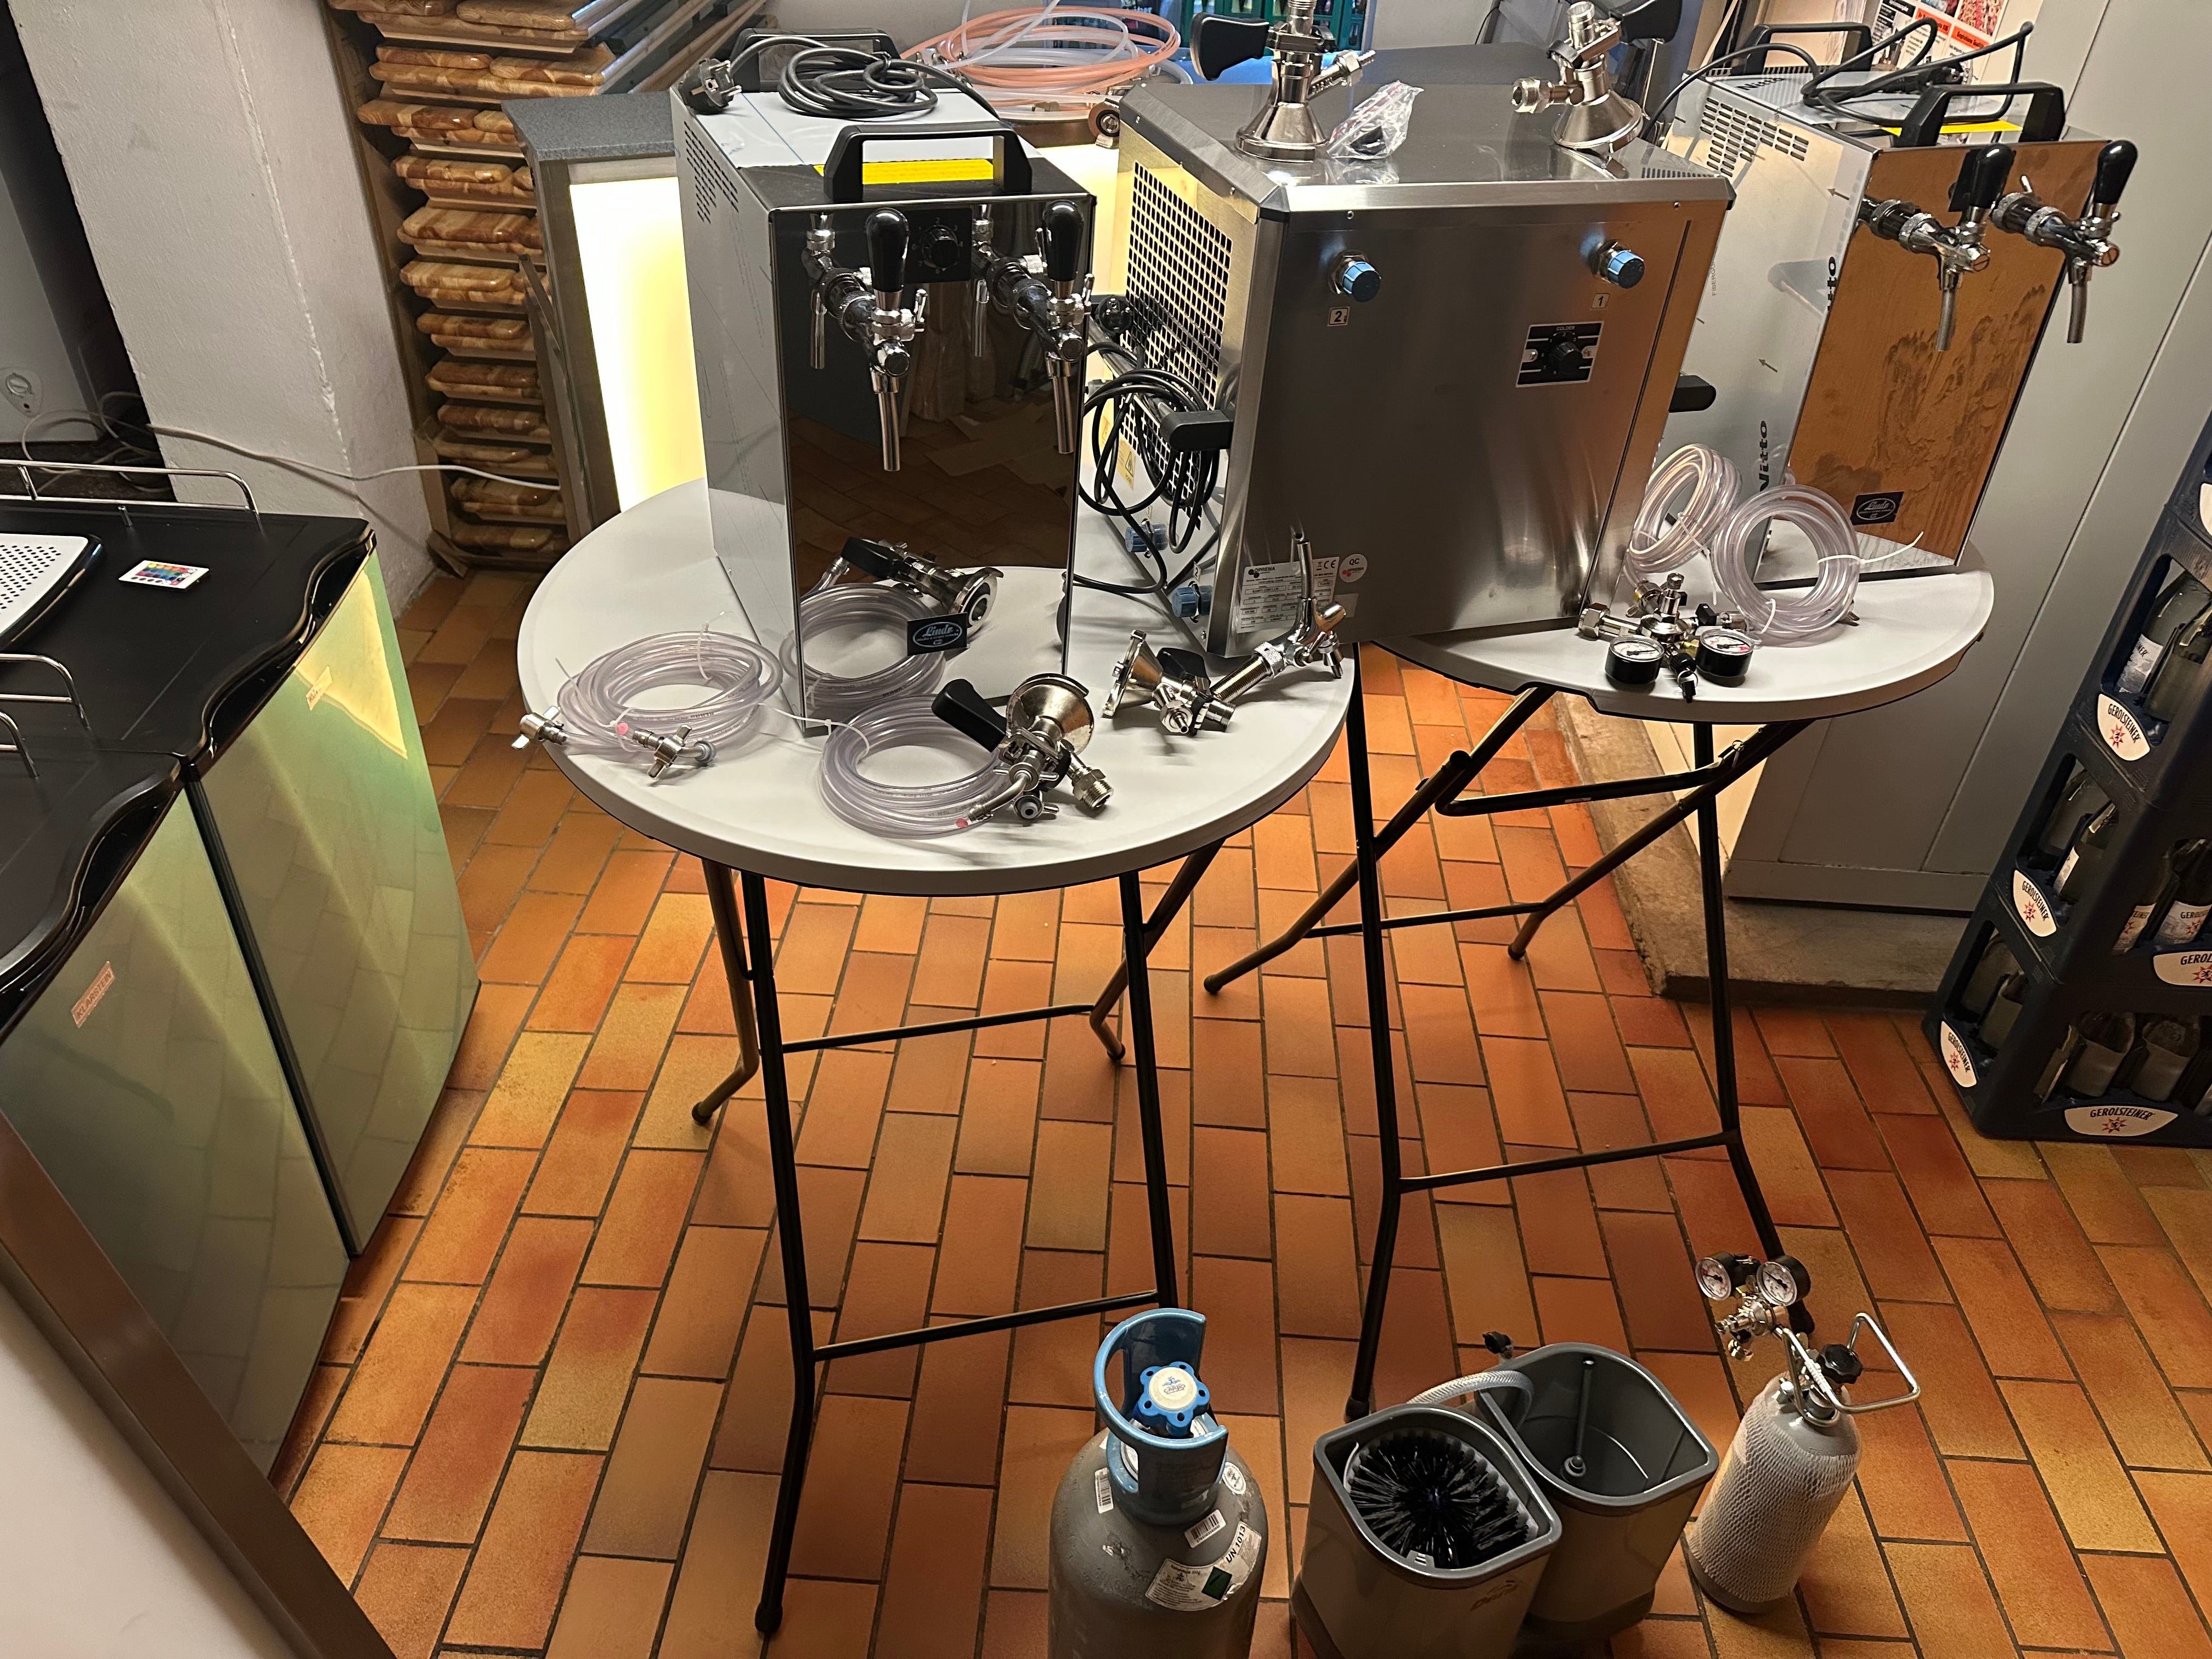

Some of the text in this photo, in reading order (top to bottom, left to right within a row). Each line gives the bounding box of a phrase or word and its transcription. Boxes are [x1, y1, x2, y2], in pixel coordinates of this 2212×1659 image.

[1735, 77, 1785, 91] Nitto
[1334, 310, 1342, 323] 2
[2108, 703, 2140, 743] GEROLSTEINER
[2022, 881, 2049, 922] GEROLSTEINER
[76, 970, 112, 1020] KLARSTEIN
[1948, 1032, 1970, 1073] GEROLSTEINER
[2090, 1107, 2153, 1121] GEROLSTEINER
[1226, 1526, 1245, 1563] UN 1013
